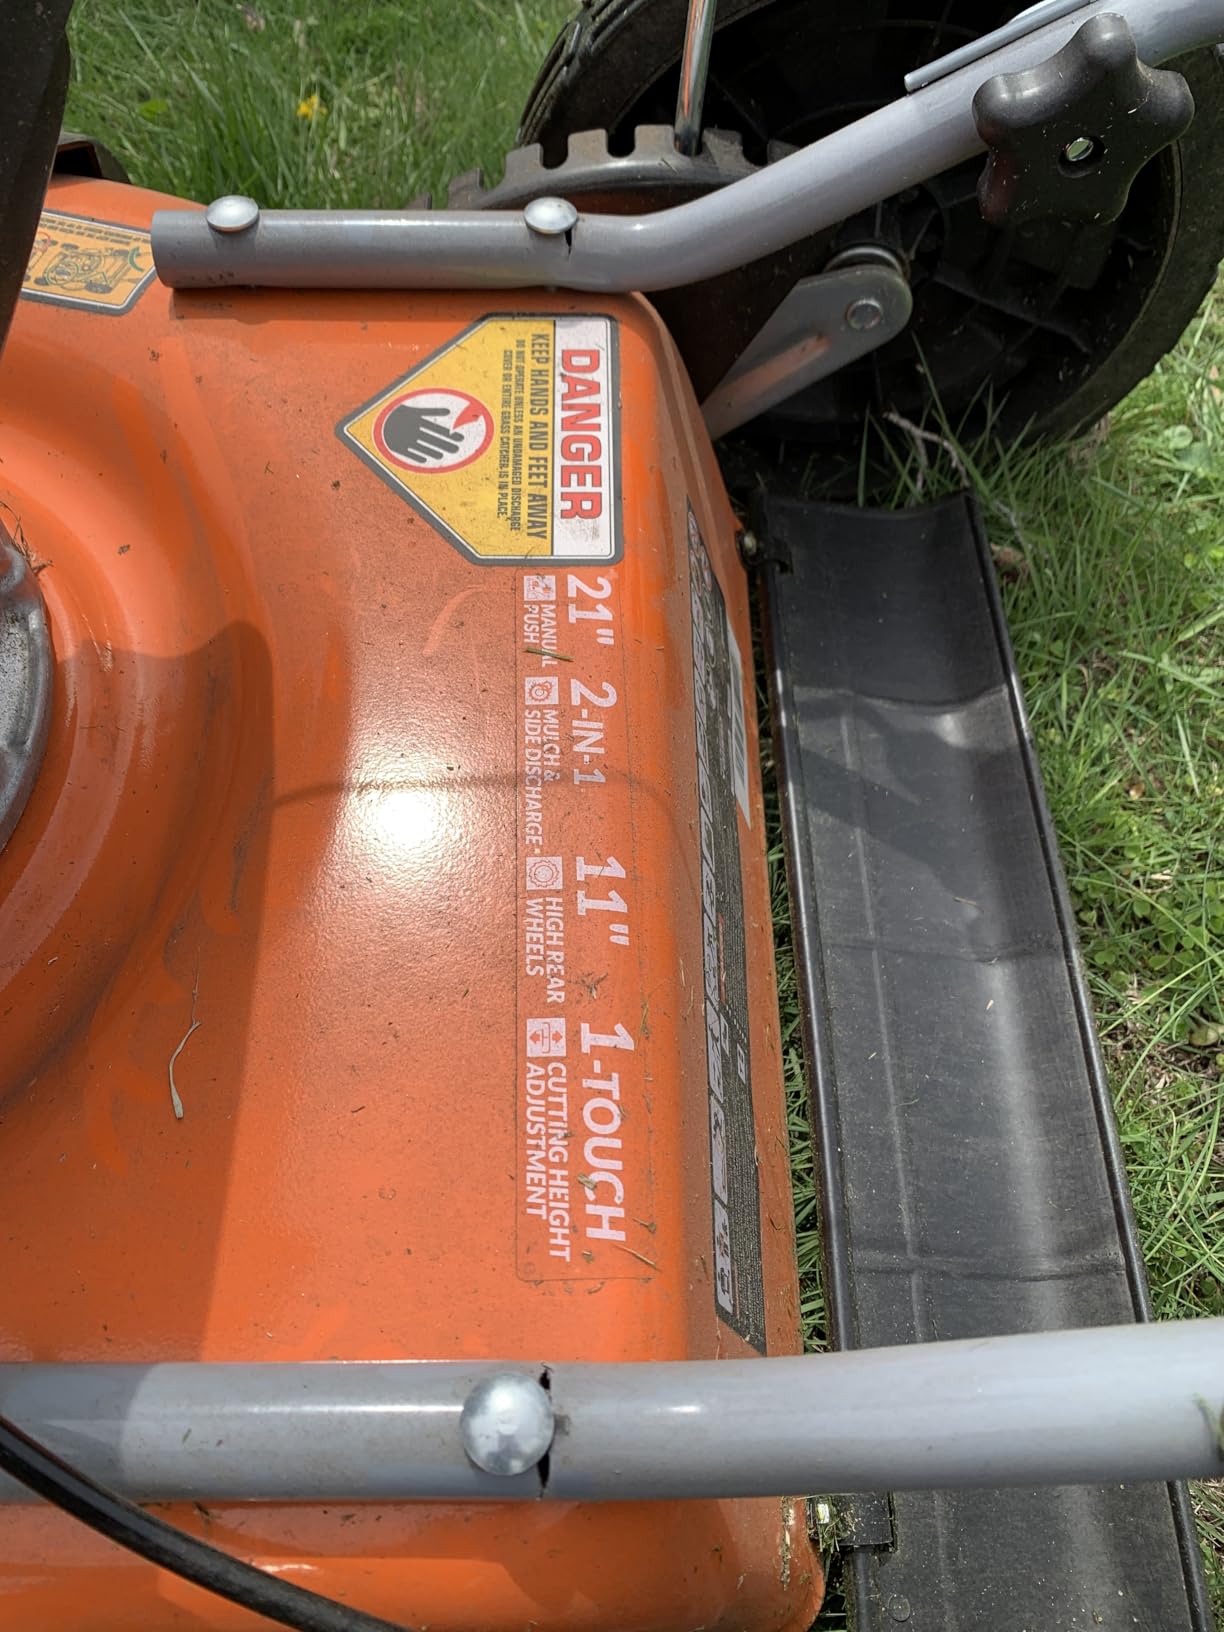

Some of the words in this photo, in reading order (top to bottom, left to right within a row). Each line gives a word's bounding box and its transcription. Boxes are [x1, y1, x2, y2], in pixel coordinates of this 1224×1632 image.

[503, 349, 513, 370] COVER
[530, 333, 549, 364] KEEP
[501, 384, 511, 409] ENTIRE
[502, 373, 512, 382] OR
[514, 365, 525, 394] OPERATE
[529, 369, 549, 416] HANDS
[500, 411, 511, 434] GRASS
[513, 425, 523, 435] AN
[514, 396, 524, 422] UNLESS
[499, 437, 510, 470] CATCHER
[529, 421, 548, 450] AND
[561, 348, 602, 519] DANGER
[499, 471, 509, 479] IS
[512, 437, 523, 485] UNDAMAGED
[528, 457, 548, 488] FEET
[498, 481, 509, 491] IN
[510, 488, 522, 531] DISCHARGE
[527, 493, 547, 539] AWAY
[523, 604, 540, 643] PUSH
[567, 574, 614, 645] 21"
[524, 709, 542, 744] SIDE
[542, 709, 561, 766] MULCH
[570, 678, 618, 785] 2-IN-1
[524, 748, 543, 846] DISCHARGE
[543, 769, 561, 782] &
[545, 897, 564, 946] HIGH
[576, 856, 630, 945] 11"
[525, 898, 544, 977] WHEELS
[546, 950, 565, 1004] REAR
[547, 1062, 569, 1163] CUTTING
[580, 1023, 636, 1242] 1-TOUCH
[526, 1062, 547, 1220] ADJUSTMENT
[548, 1170, 570, 1263] HEIGHT
